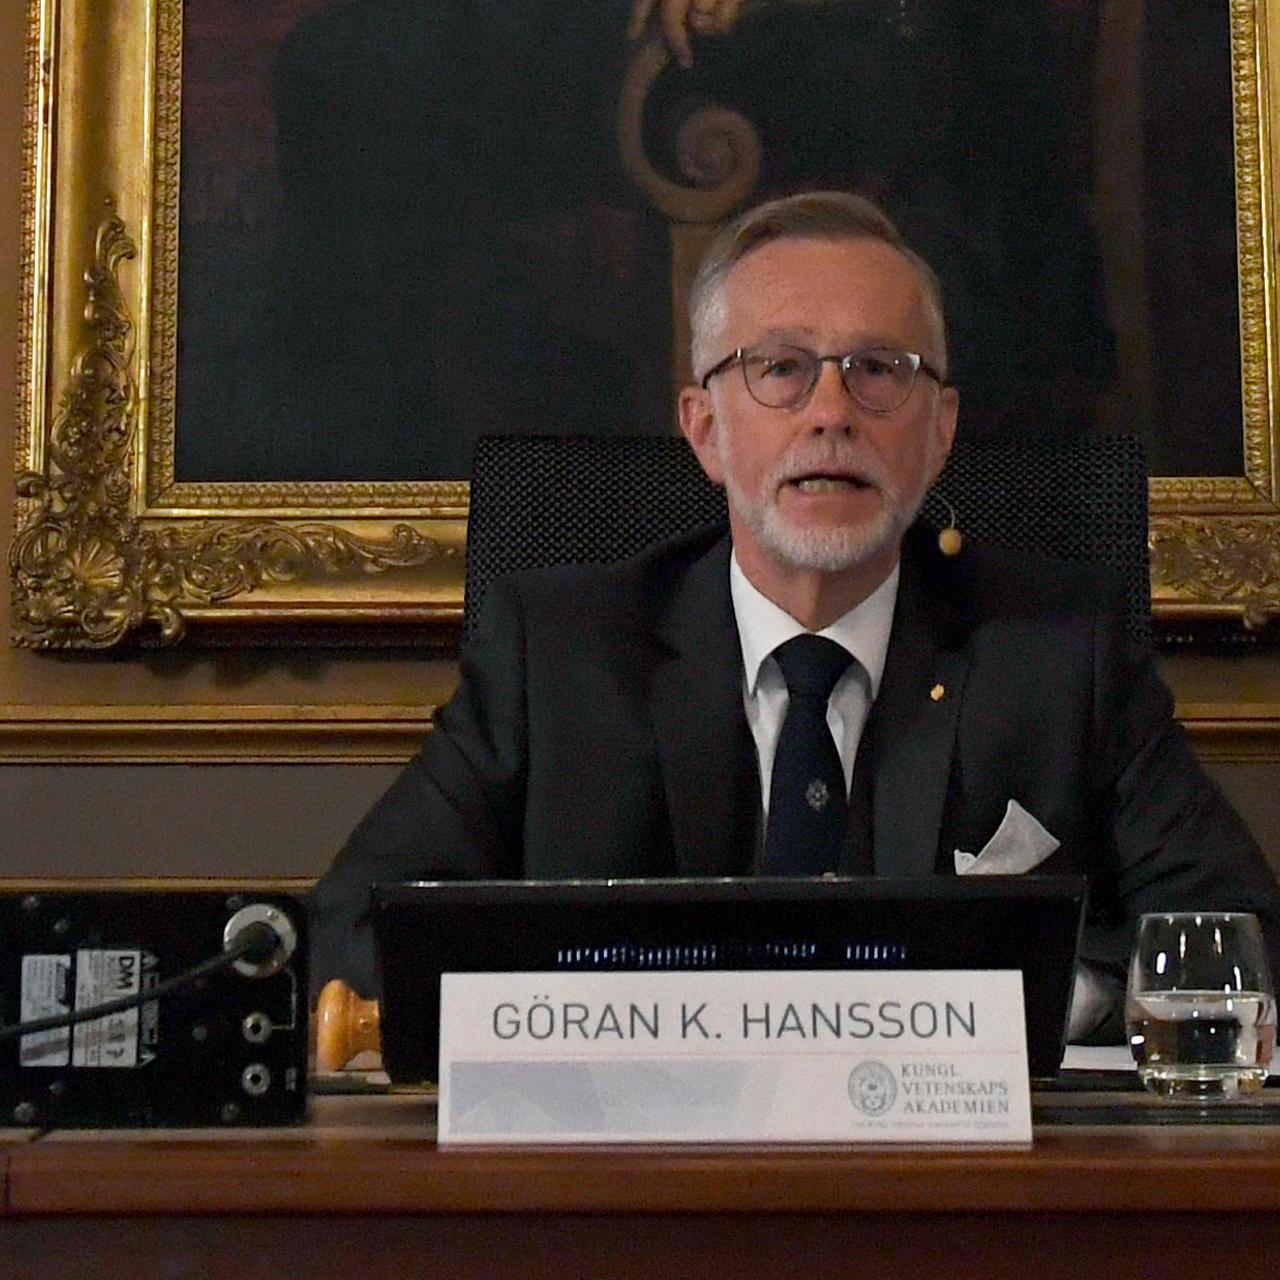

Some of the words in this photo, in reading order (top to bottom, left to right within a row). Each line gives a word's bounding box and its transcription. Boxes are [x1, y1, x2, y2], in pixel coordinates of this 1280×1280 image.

[492, 995, 659, 1040] GÖRAN
[681, 1003, 722, 1039] K.
[742, 1001, 976, 1039] HANSSON
[902, 1099, 1010, 1115] AKADEMIEN
